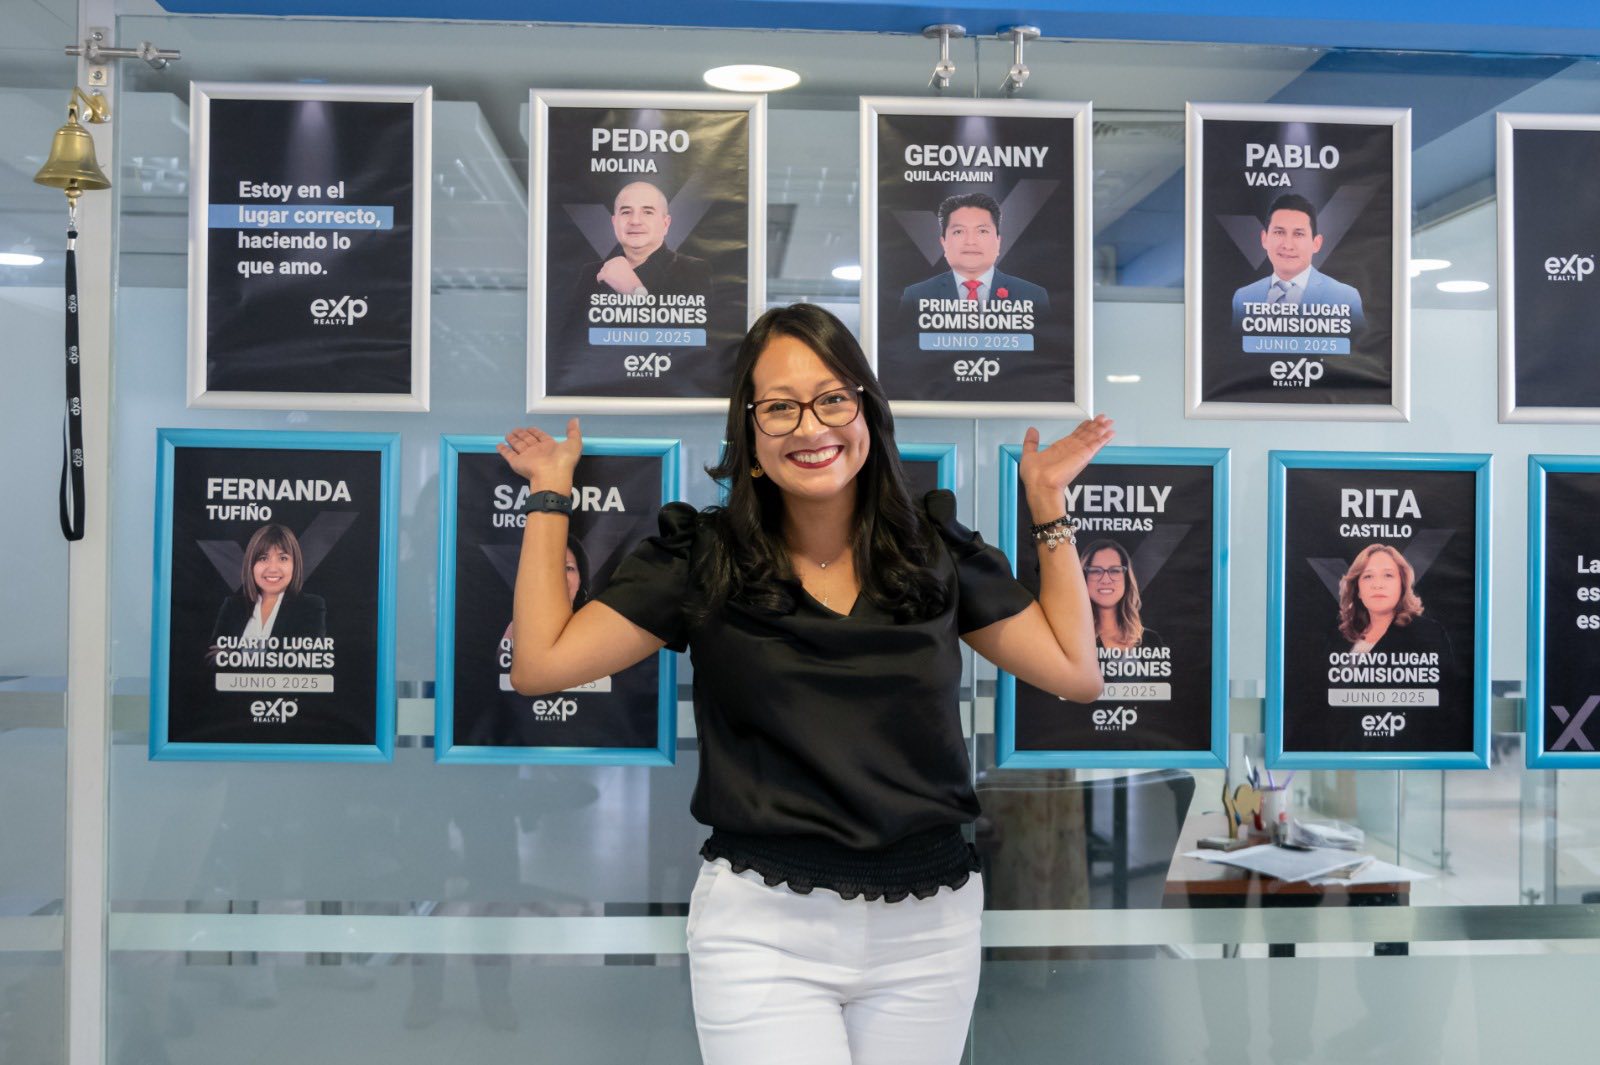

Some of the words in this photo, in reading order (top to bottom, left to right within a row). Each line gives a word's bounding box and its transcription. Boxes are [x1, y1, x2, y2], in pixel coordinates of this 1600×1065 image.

[592, 128, 689, 153] PEDRO
[904, 145, 1048, 167] GEOVANNY
[1246, 143, 1339, 169] PABLO
[591, 158, 657, 172] MOLINA
[904, 171, 993, 182] QUILACHAMIN
[1245, 172, 1291, 187] VACA
[239, 181, 292, 202] Estoy
[298, 184, 321, 198] en
[327, 181, 344, 199] el
[239, 206, 288, 227] lugar
[294, 209, 381, 227] correcto,
[238, 231, 327, 249] haciendo
[333, 233, 351, 249] lo
[238, 261, 274, 278] que
[279, 262, 327, 275] amo.
[590, 294, 656, 306] SEGUNDO
[660, 295, 705, 307] LUGAR
[919, 299, 978, 312] PRIMER
[983, 300, 1034, 313] LUGAR
[588, 307, 707, 323] COMISIONES
[1243, 303, 1299, 316] TERCER
[1303, 304, 1350, 316] LUGAR
[919, 314, 1034, 329] COMISIONES
[1242, 317, 1351, 333] COMISIONES
[603, 331, 649, 343] JUNIO
[655, 331, 691, 343] 2025
[933, 336, 978, 347] JUNIO
[984, 337, 1019, 348] 2025
[1256, 339, 1298, 350] JUNIO
[1304, 339, 1337, 351] 2025
[207, 478, 351, 502] FERNANDA
[1064, 485, 1172, 512] YERILY
[1341, 489, 1421, 518] RITA
[206, 502, 272, 521] TUFIÑO
[1071, 518, 1153, 531] ONTRERAS
[1340, 525, 1412, 538] CASTILLO
[217, 636, 279, 650] CUARTO
[283, 637, 334, 650] LUGAR
[216, 651, 335, 668] COMISIONES
[1125, 647, 1170, 659] LUGAR
[1329, 653, 1387, 665] OCTAVO
[1391, 653, 1438, 666] LUGAR
[1100, 661, 1171, 677] ISIONES
[1328, 667, 1440, 683] COMISIONES
[230, 677, 276, 688] JUNIO
[283, 677, 318, 689] 2025
[1123, 686, 1156, 697] 2025
[1342, 692, 1385, 703] JUNIO
[1392, 692, 1425, 703] 2025
